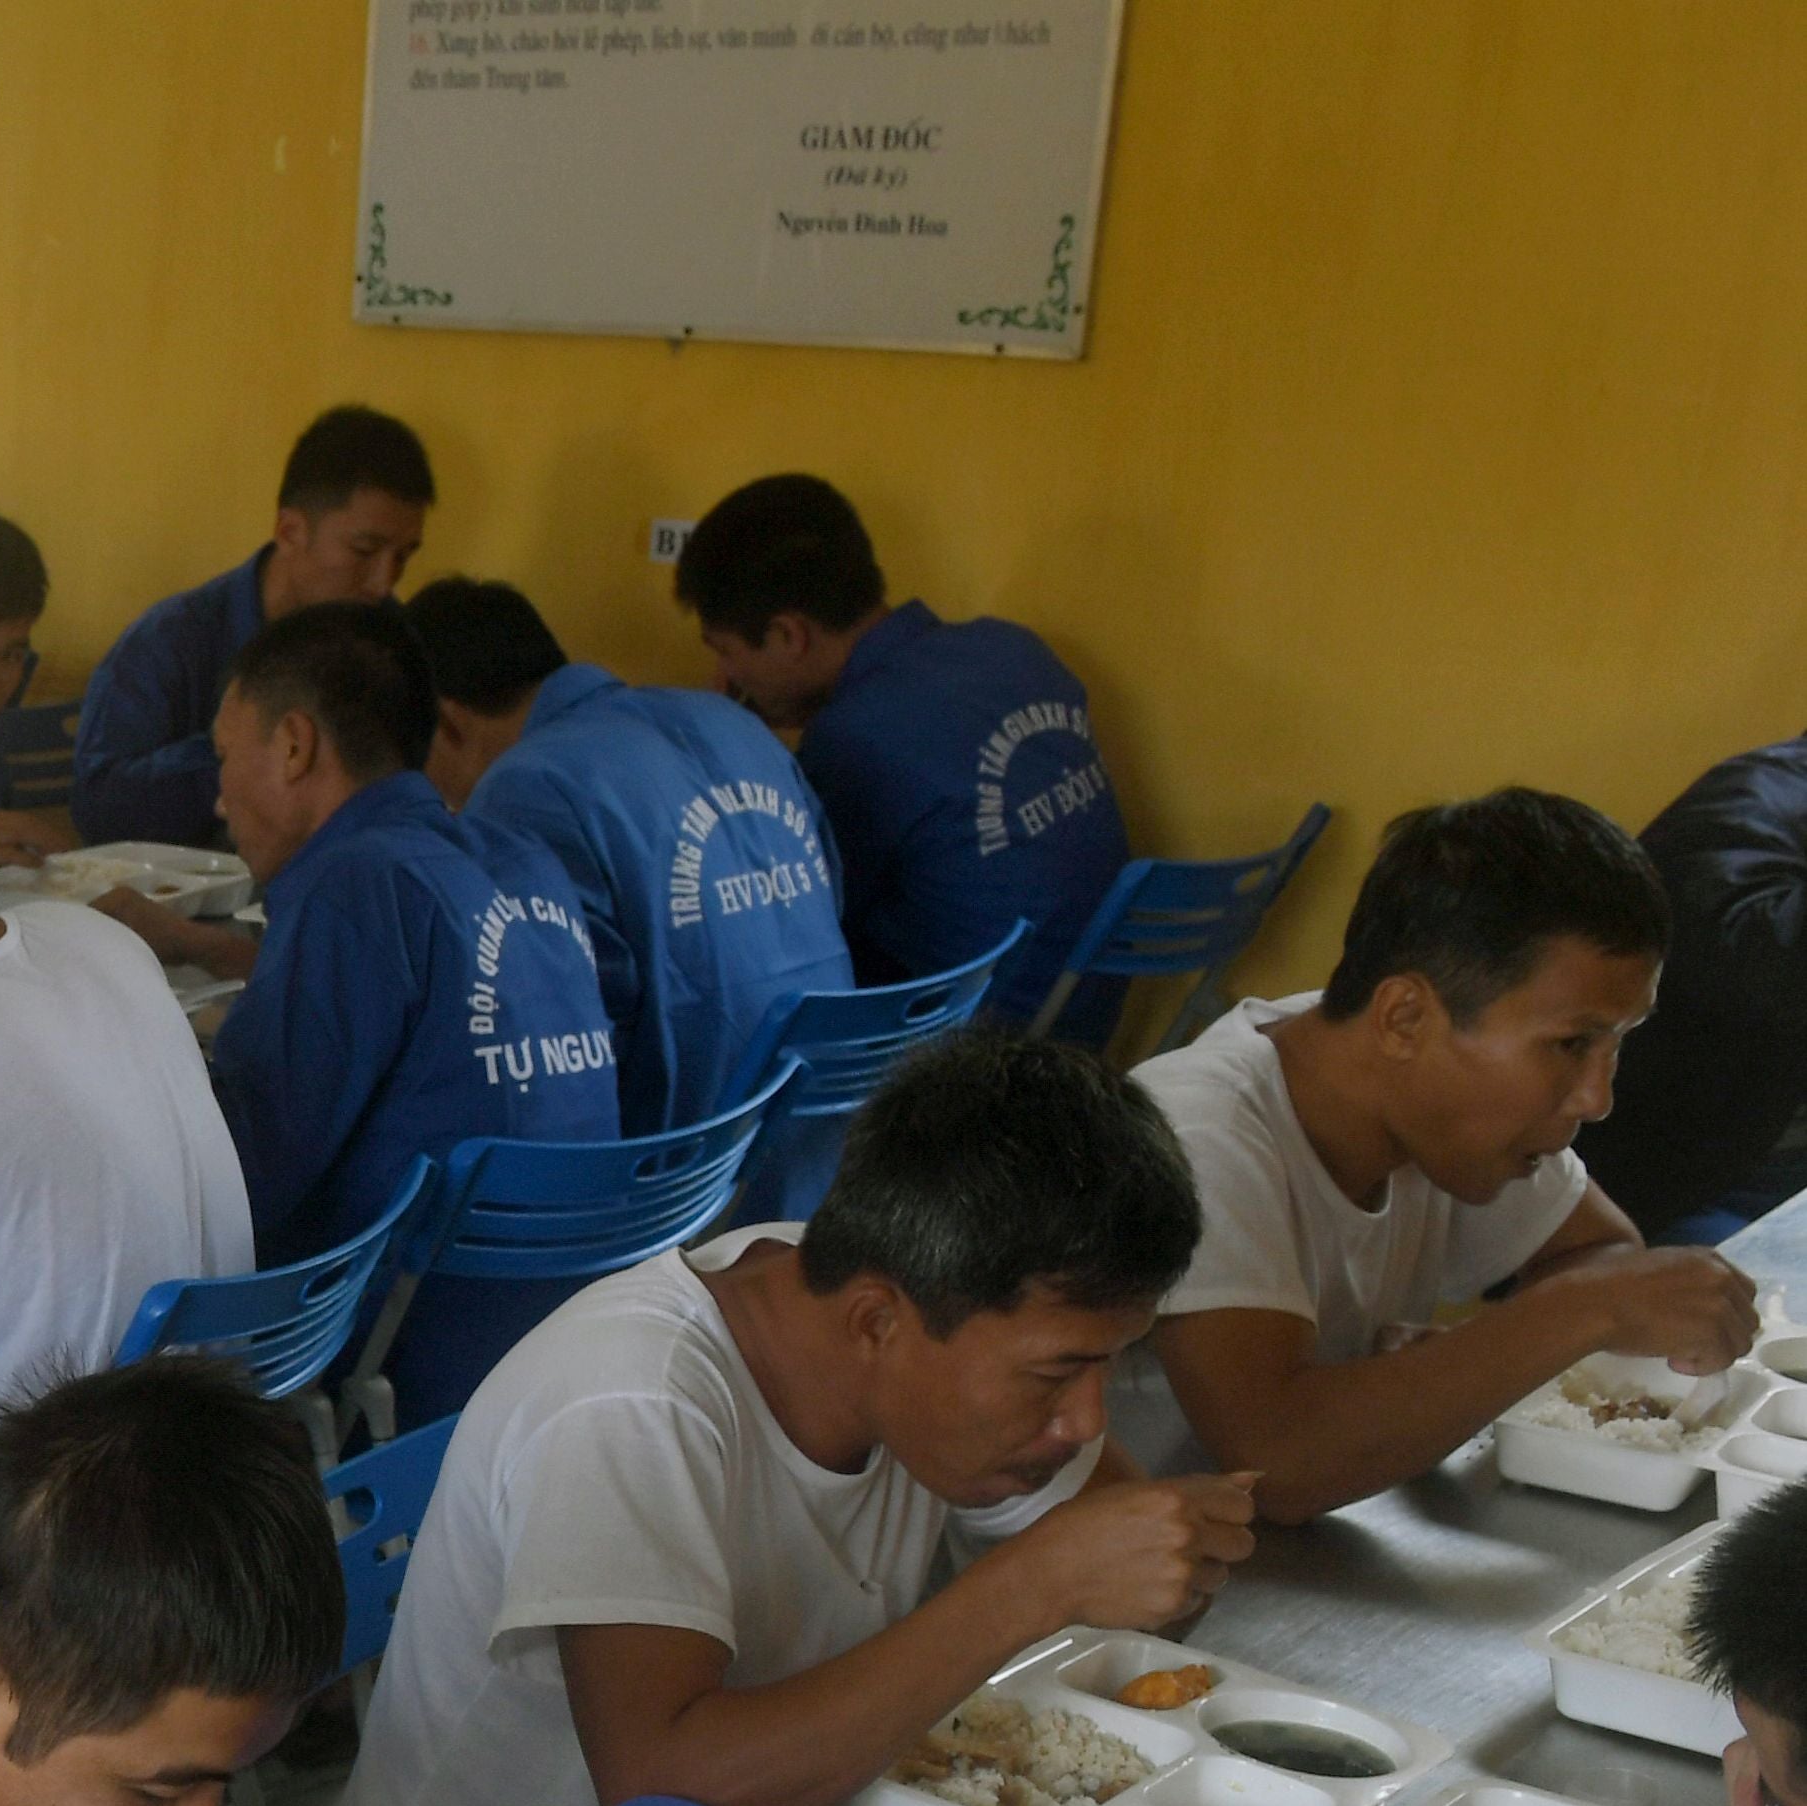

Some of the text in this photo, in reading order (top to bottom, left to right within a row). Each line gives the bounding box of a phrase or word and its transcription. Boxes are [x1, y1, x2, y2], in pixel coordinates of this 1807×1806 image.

[529, 895, 569, 930] CAI
[714, 873, 753, 916] HV
[473, 1029, 618, 1094] TỰ NGUY
